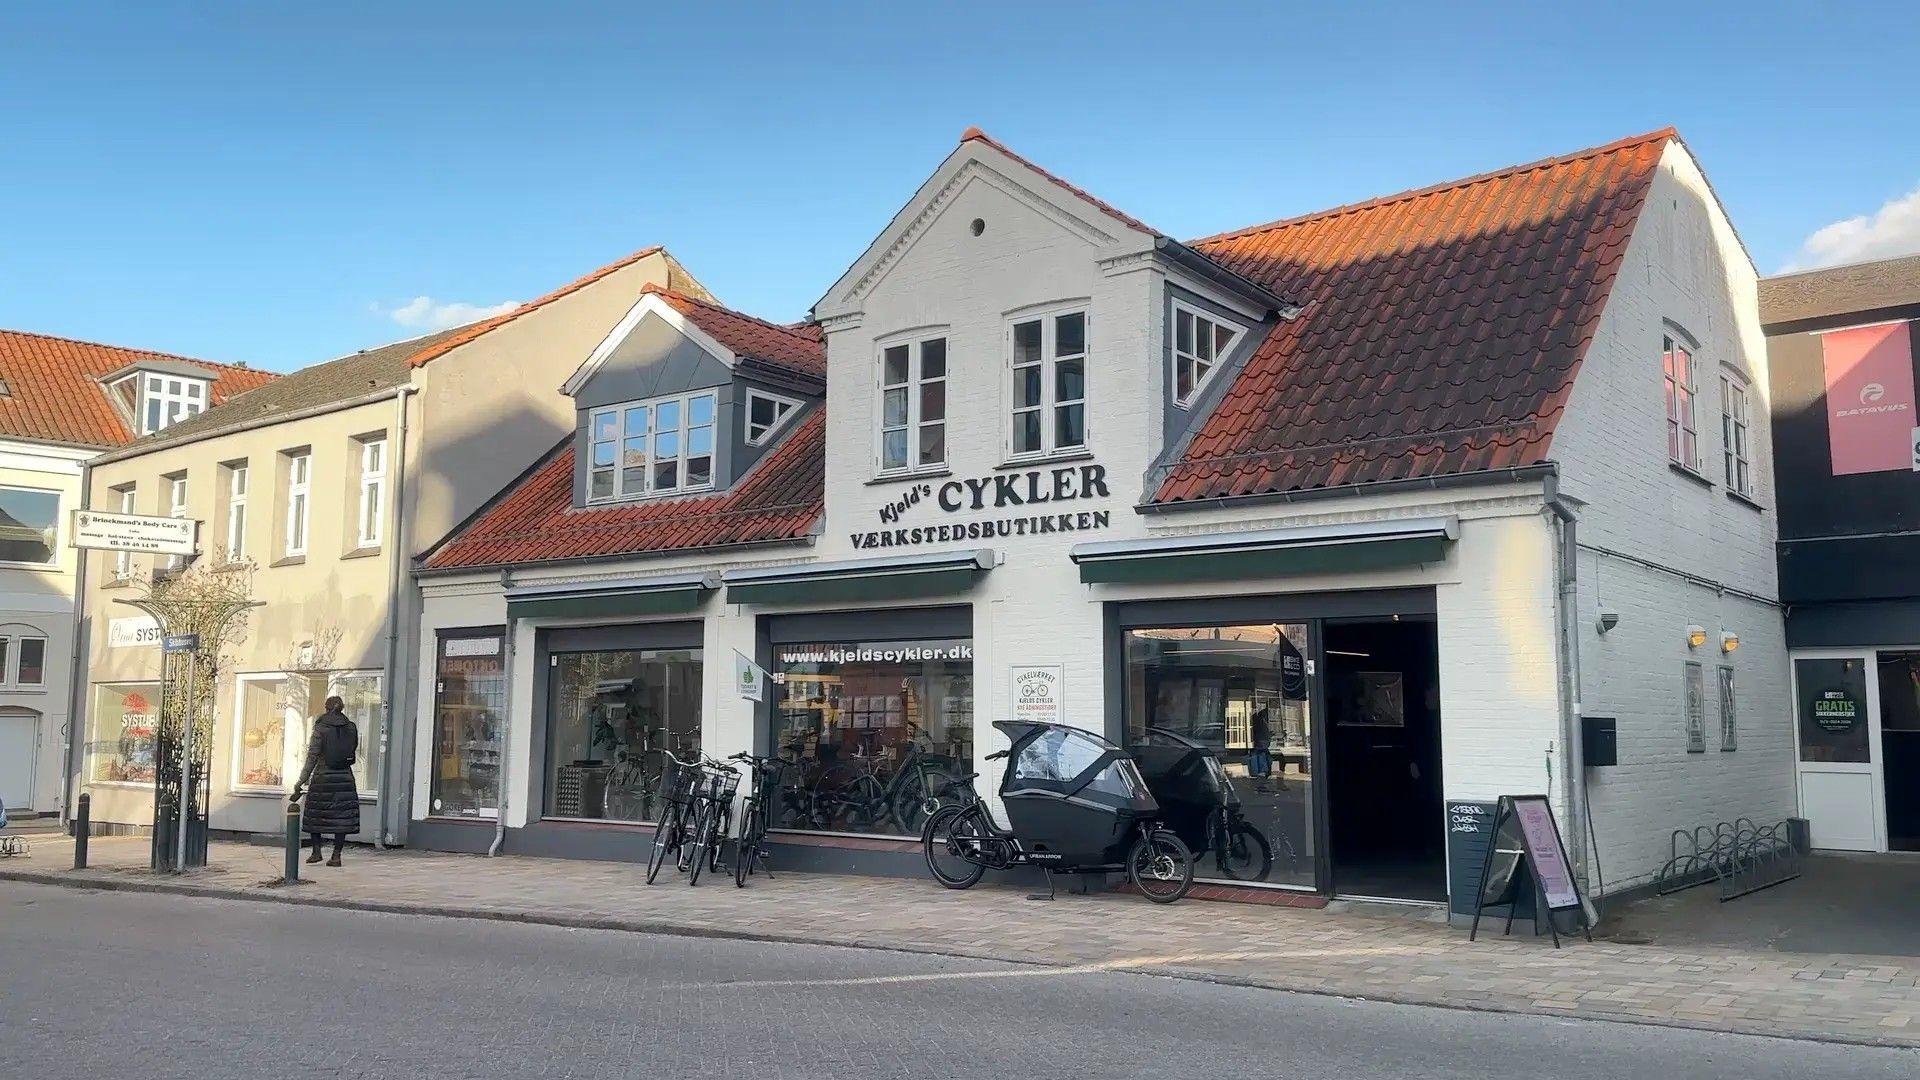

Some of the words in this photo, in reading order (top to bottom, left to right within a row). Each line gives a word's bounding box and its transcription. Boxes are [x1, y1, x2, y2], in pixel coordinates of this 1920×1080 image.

[1836, 403, 1907, 416] BATAVUS
[878, 484, 931, 525] Kjeld's
[938, 464, 1111, 512] CYKLER
[142, 520, 160, 528] Body
[850, 510, 1110, 549] VÆRKSTEDSBUTIKKEN
[783, 645, 973, 665] www.kjeldscykler.dk
[1815, 700, 1855, 711] GRATIS
